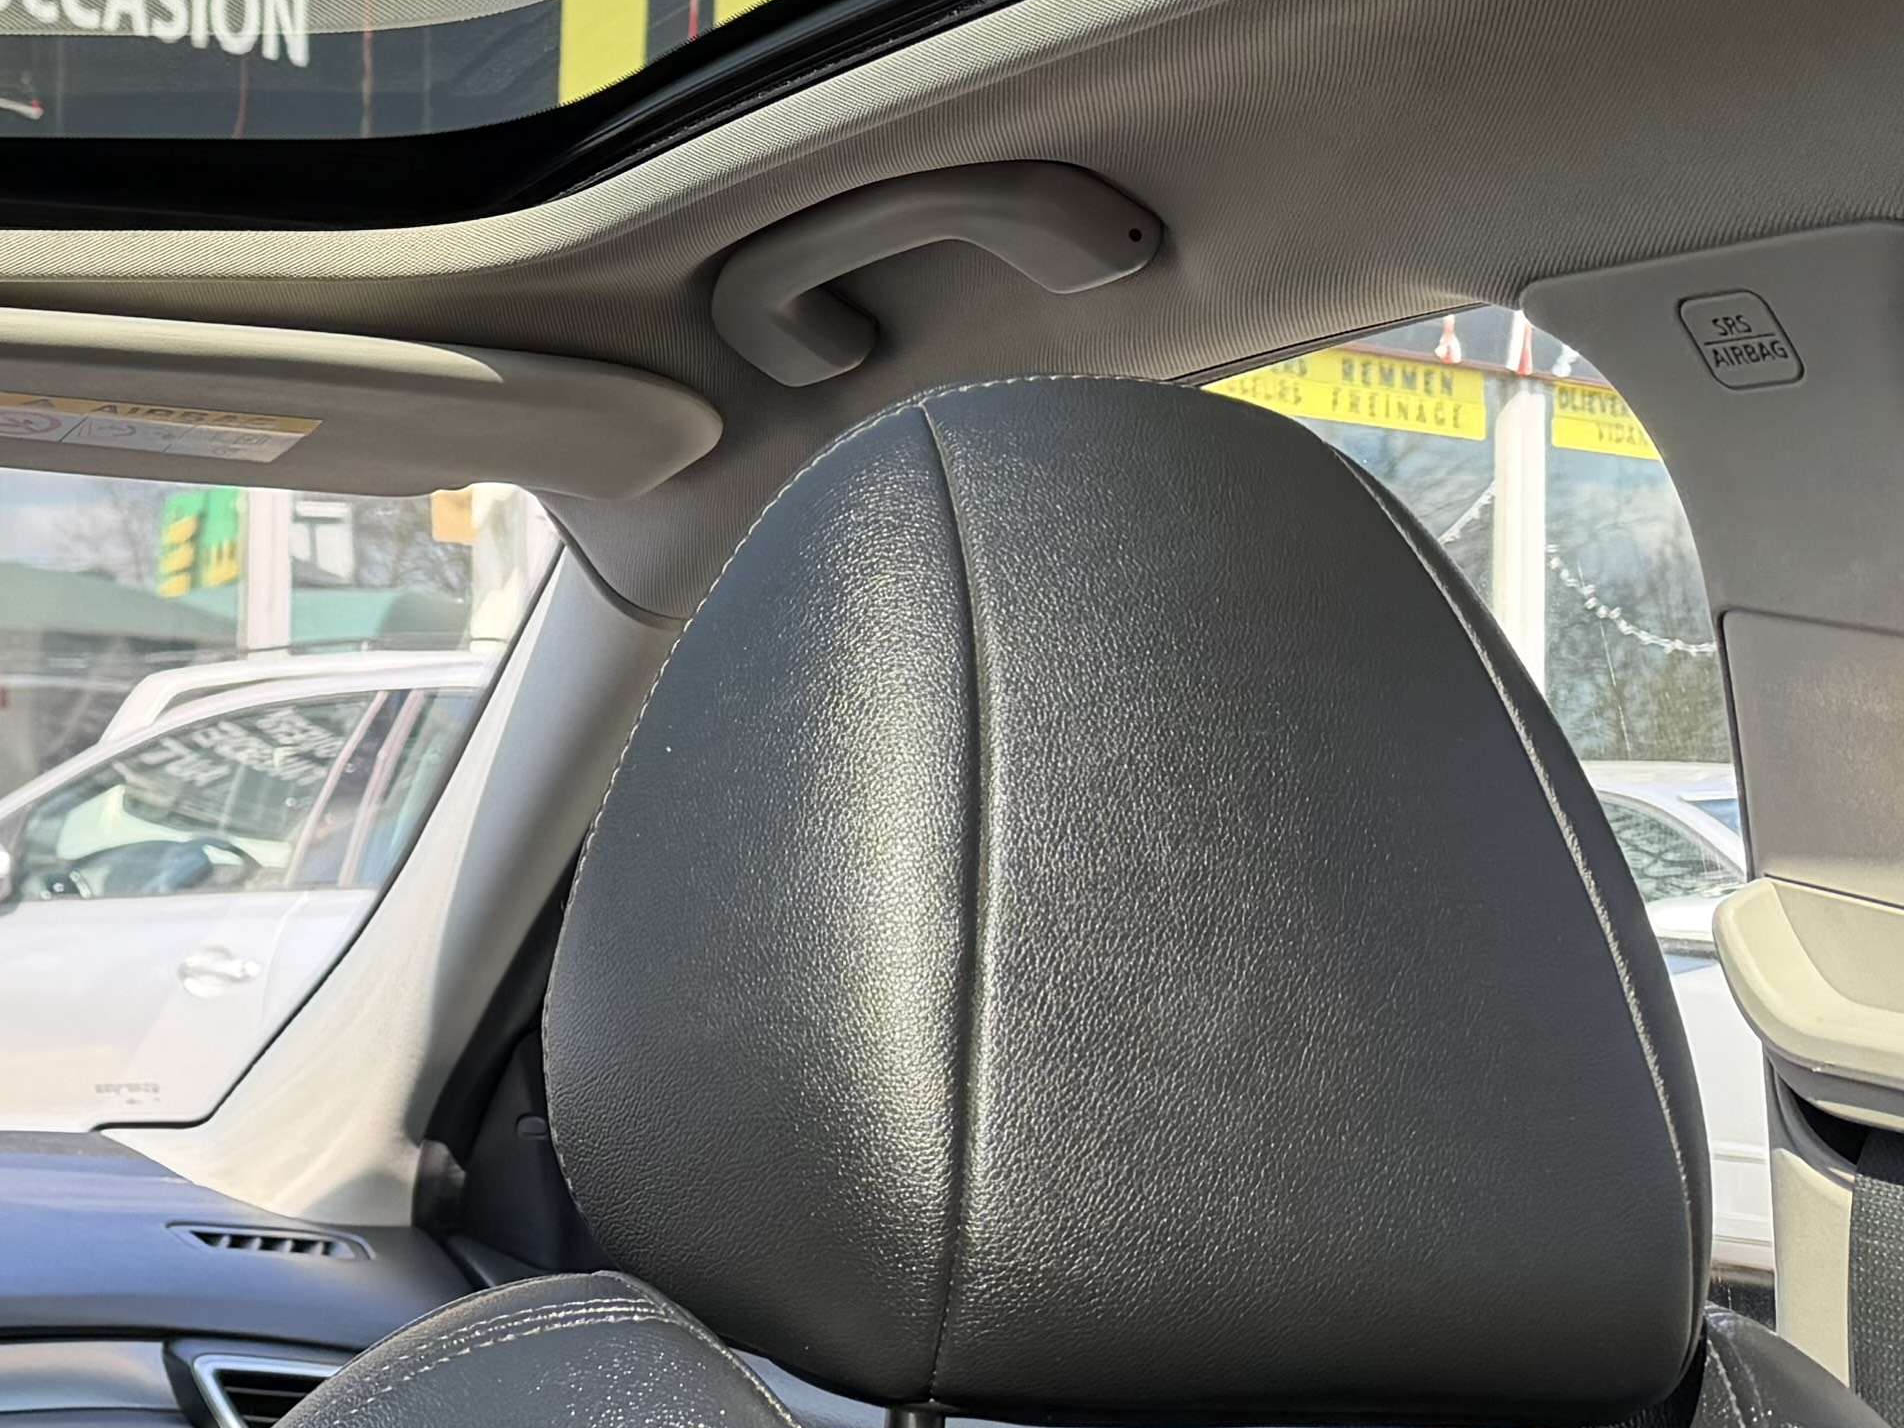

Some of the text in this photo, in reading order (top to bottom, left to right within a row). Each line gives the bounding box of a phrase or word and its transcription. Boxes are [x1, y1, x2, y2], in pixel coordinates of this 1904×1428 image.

[1712, 314, 1752, 336] SRS
[1713, 339, 1789, 368] AIRBAG
[1332, 387, 1462, 429] FREINAGE
